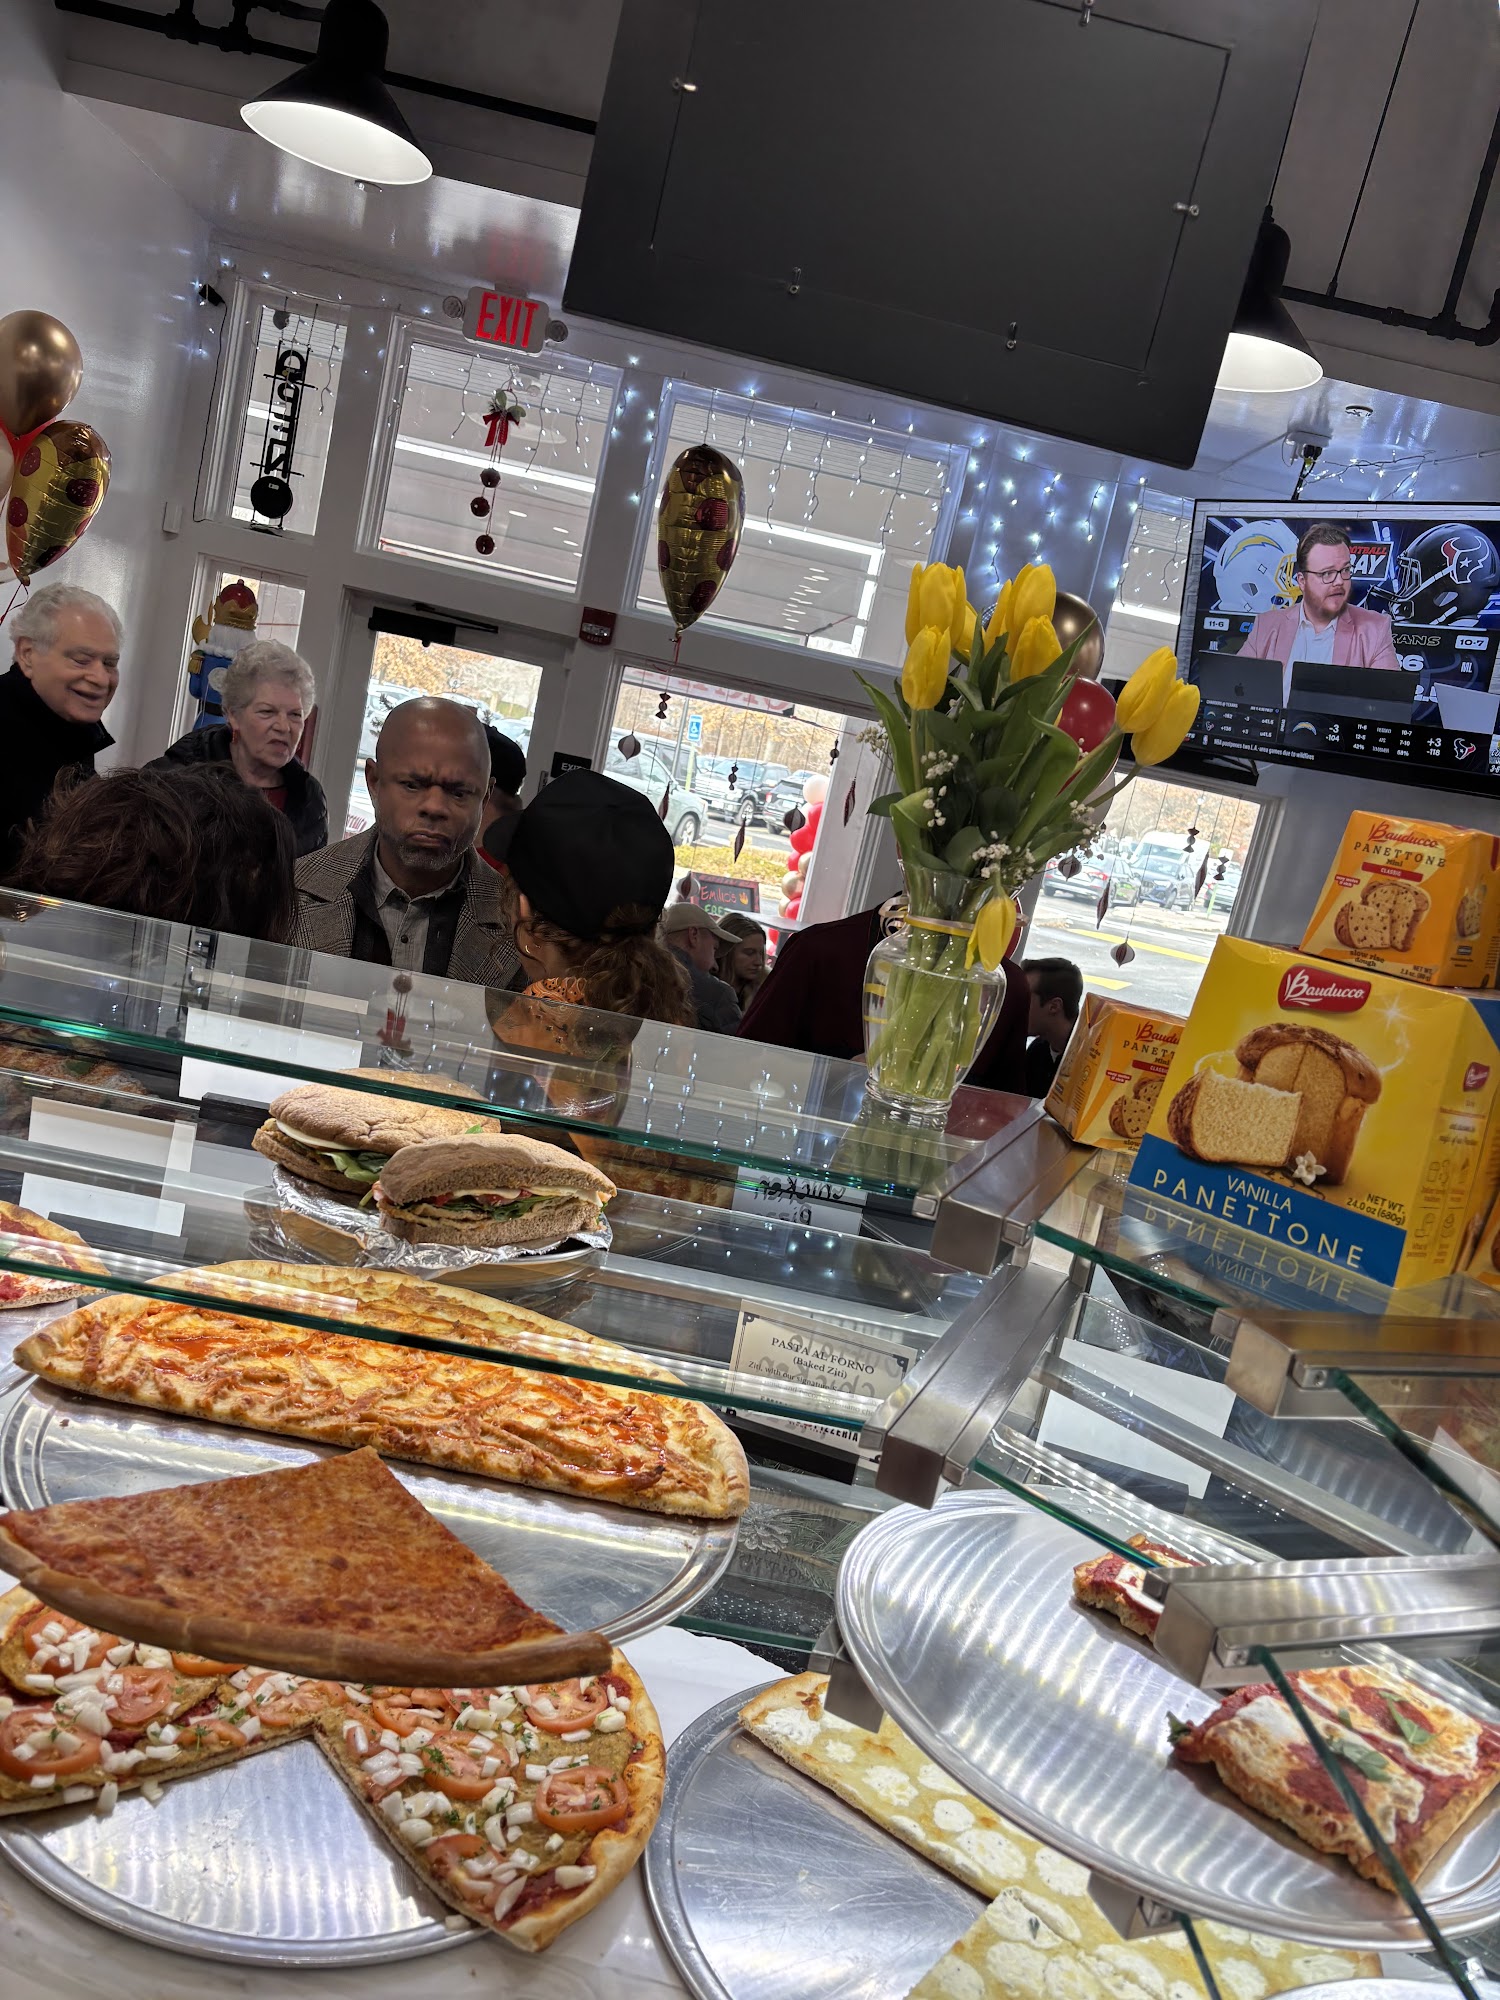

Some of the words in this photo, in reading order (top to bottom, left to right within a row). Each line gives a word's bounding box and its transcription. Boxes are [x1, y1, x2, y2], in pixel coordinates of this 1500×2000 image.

[476, 291, 539, 348] EXIT
[1350, 546, 1387, 555] OTBALL
[1460, 639, 1485, 647] 10-7
[1326, 734, 1340, 742] -104
[1329, 724, 1340, 733] -3
[1427, 738, 1442, 747] +3
[1369, 821, 1439, 848] Bauducco
[1354, 841, 1447, 868] PANETTONE
[1350, 950, 1368, 958] slow
[1355, 958, 1376, 967] dough
[1284, 968, 1364, 1001] Bauducco
[1227, 1174, 1292, 1213] VANILLA
[1366, 1193, 1386, 1206] NET
[1387, 1198, 1406, 1214] WT.
[1153, 1169, 1364, 1269] PANETTONE
[1346, 1197, 1366, 1212] 24.0
[1366, 1205, 1377, 1214] oz
[1377, 1206, 1406, 1226] (680g)
[771, 1337, 809, 1356] PASTA
[812, 1346, 828, 1362] AL
[830, 1354, 875, 1376] FORNO
[748, 1360, 763, 1372] Ziti,
[765, 1366, 781, 1377] with
[782, 1370, 796, 1380] our
[793, 1356, 826, 1374] (Baked
[827, 1366, 848, 1380] Ziti)
